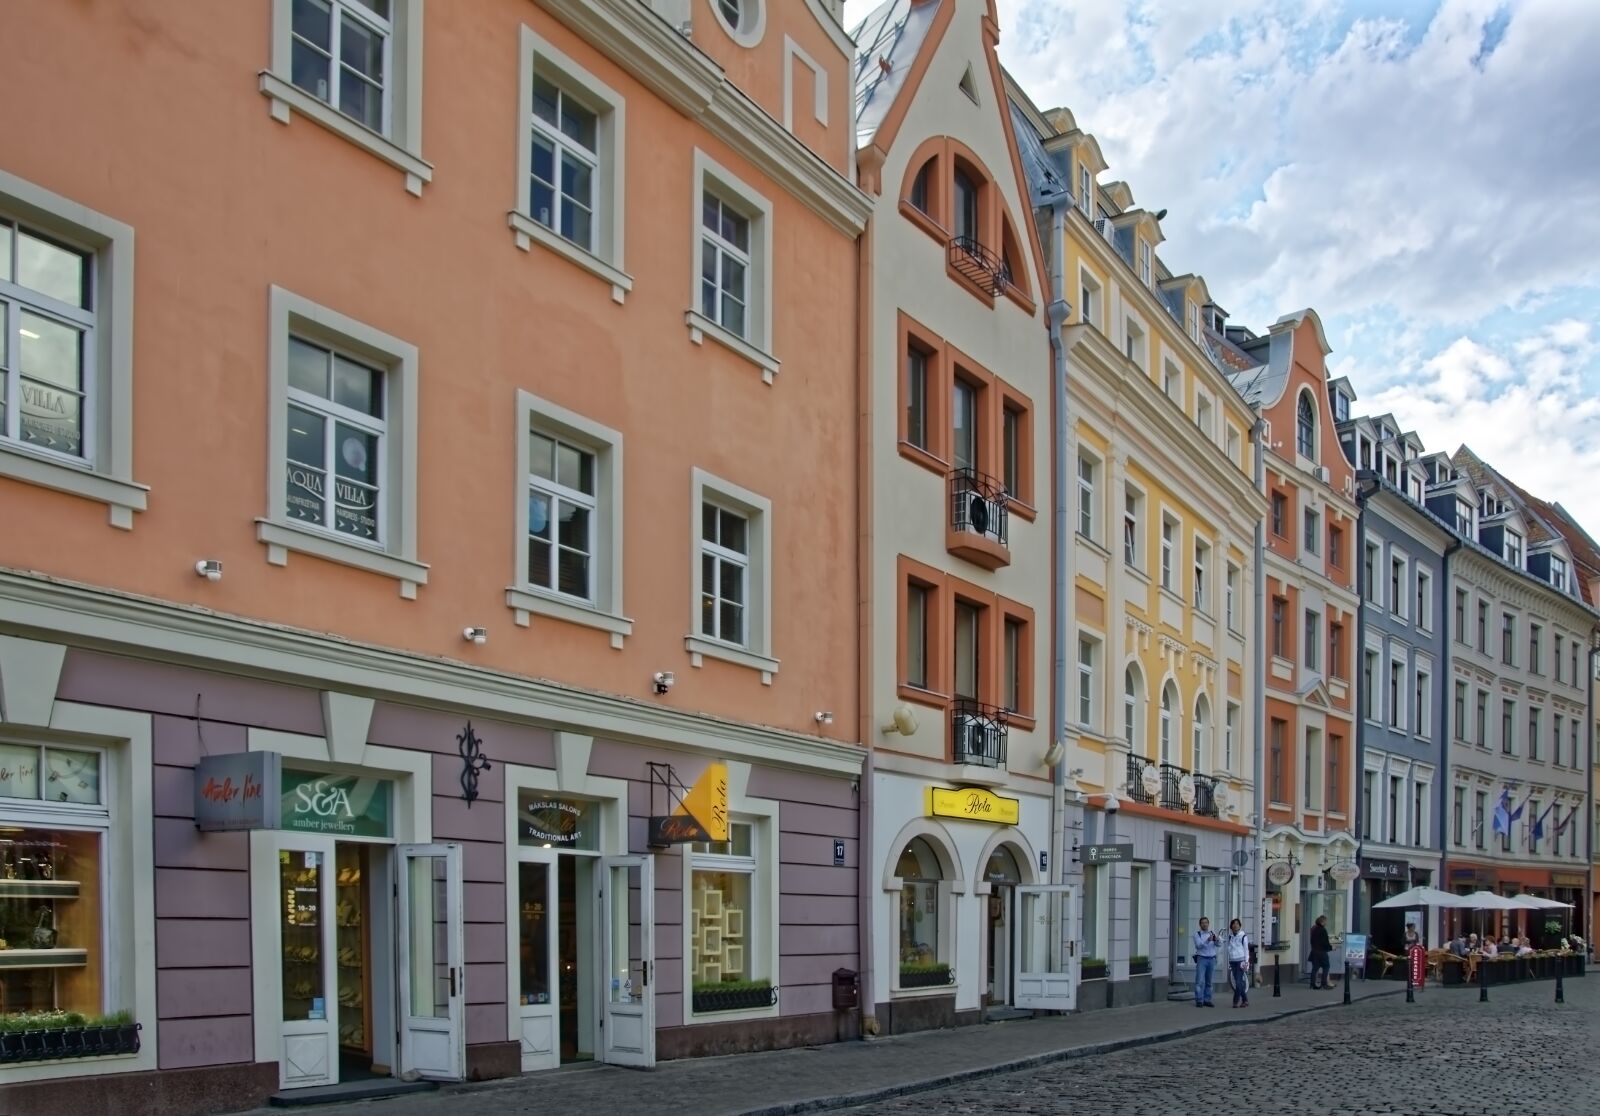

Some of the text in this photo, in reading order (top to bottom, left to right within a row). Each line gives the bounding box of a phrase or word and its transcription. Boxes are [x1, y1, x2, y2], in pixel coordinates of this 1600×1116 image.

[21, 384, 65, 414] VILLA
[287, 467, 323, 493] AQUA
[336, 482, 367, 506] VILLA
[294, 780, 354, 817] S&A
[293, 818, 356, 834] amber jewellery
[528, 826, 582, 842] TRADITIONAL ART
[836, 845, 844, 857] 17
